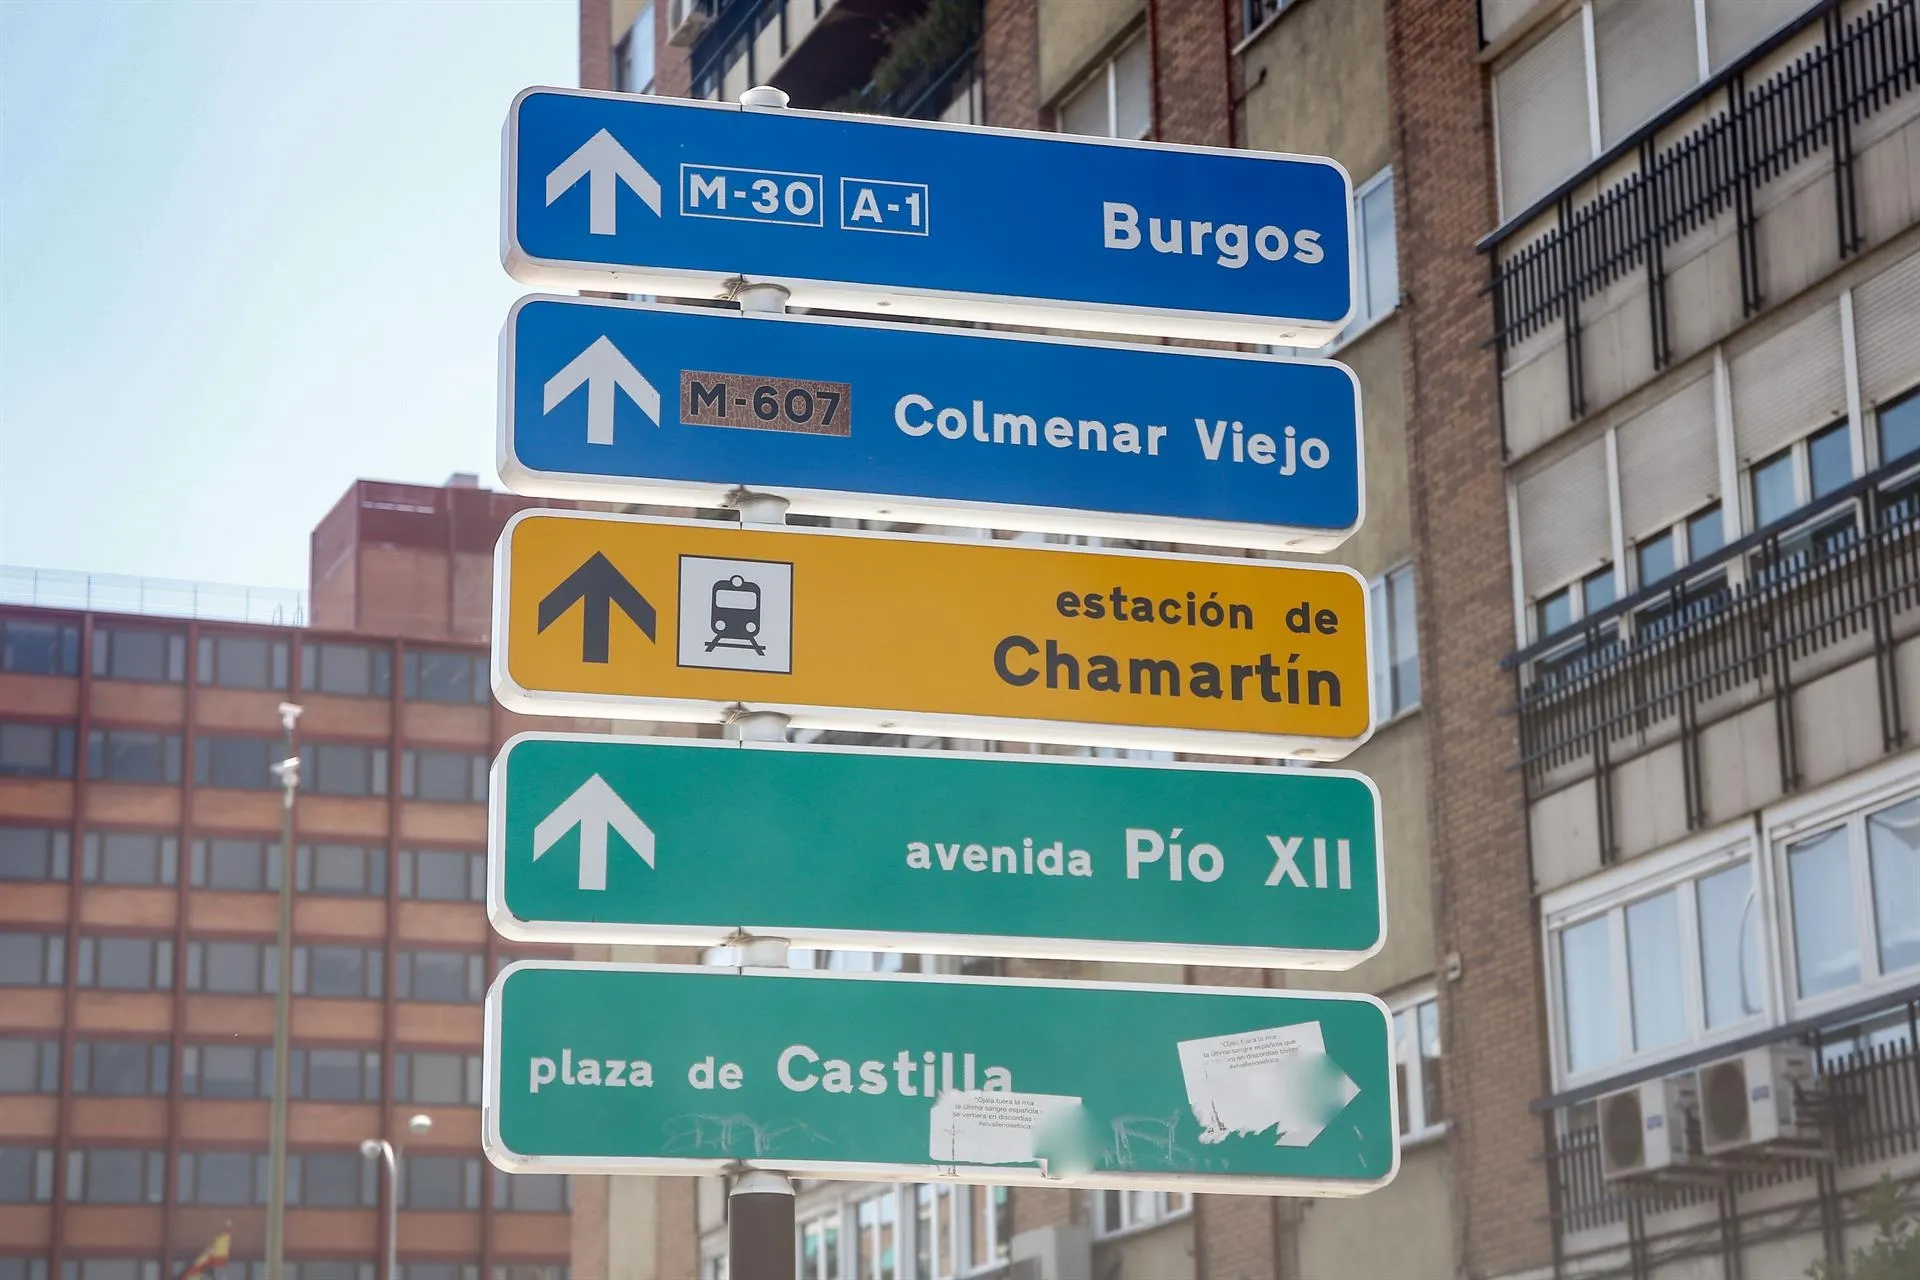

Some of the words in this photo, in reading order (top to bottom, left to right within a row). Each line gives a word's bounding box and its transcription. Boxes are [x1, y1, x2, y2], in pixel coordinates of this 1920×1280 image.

[690, 173, 814, 216] M-30
[851, 188, 920, 226] A-1
[1103, 201, 1325, 269] Burgos
[690, 381, 841, 426] M-607
[894, 393, 1167, 456] Colmenar
[1194, 418, 1330, 476] Viejo
[1056, 586, 1254, 631] estación
[1285, 602, 1339, 635] de
[993, 634, 1342, 708] Chamartín
[906, 837, 1094, 878] avenida
[1125, 828, 1225, 883] Pío
[1264, 835, 1352, 890] XII
[529, 1048, 655, 1094] plaza
[687, 1056, 744, 1090] de
[777, 1044, 1013, 1098] Castilla
